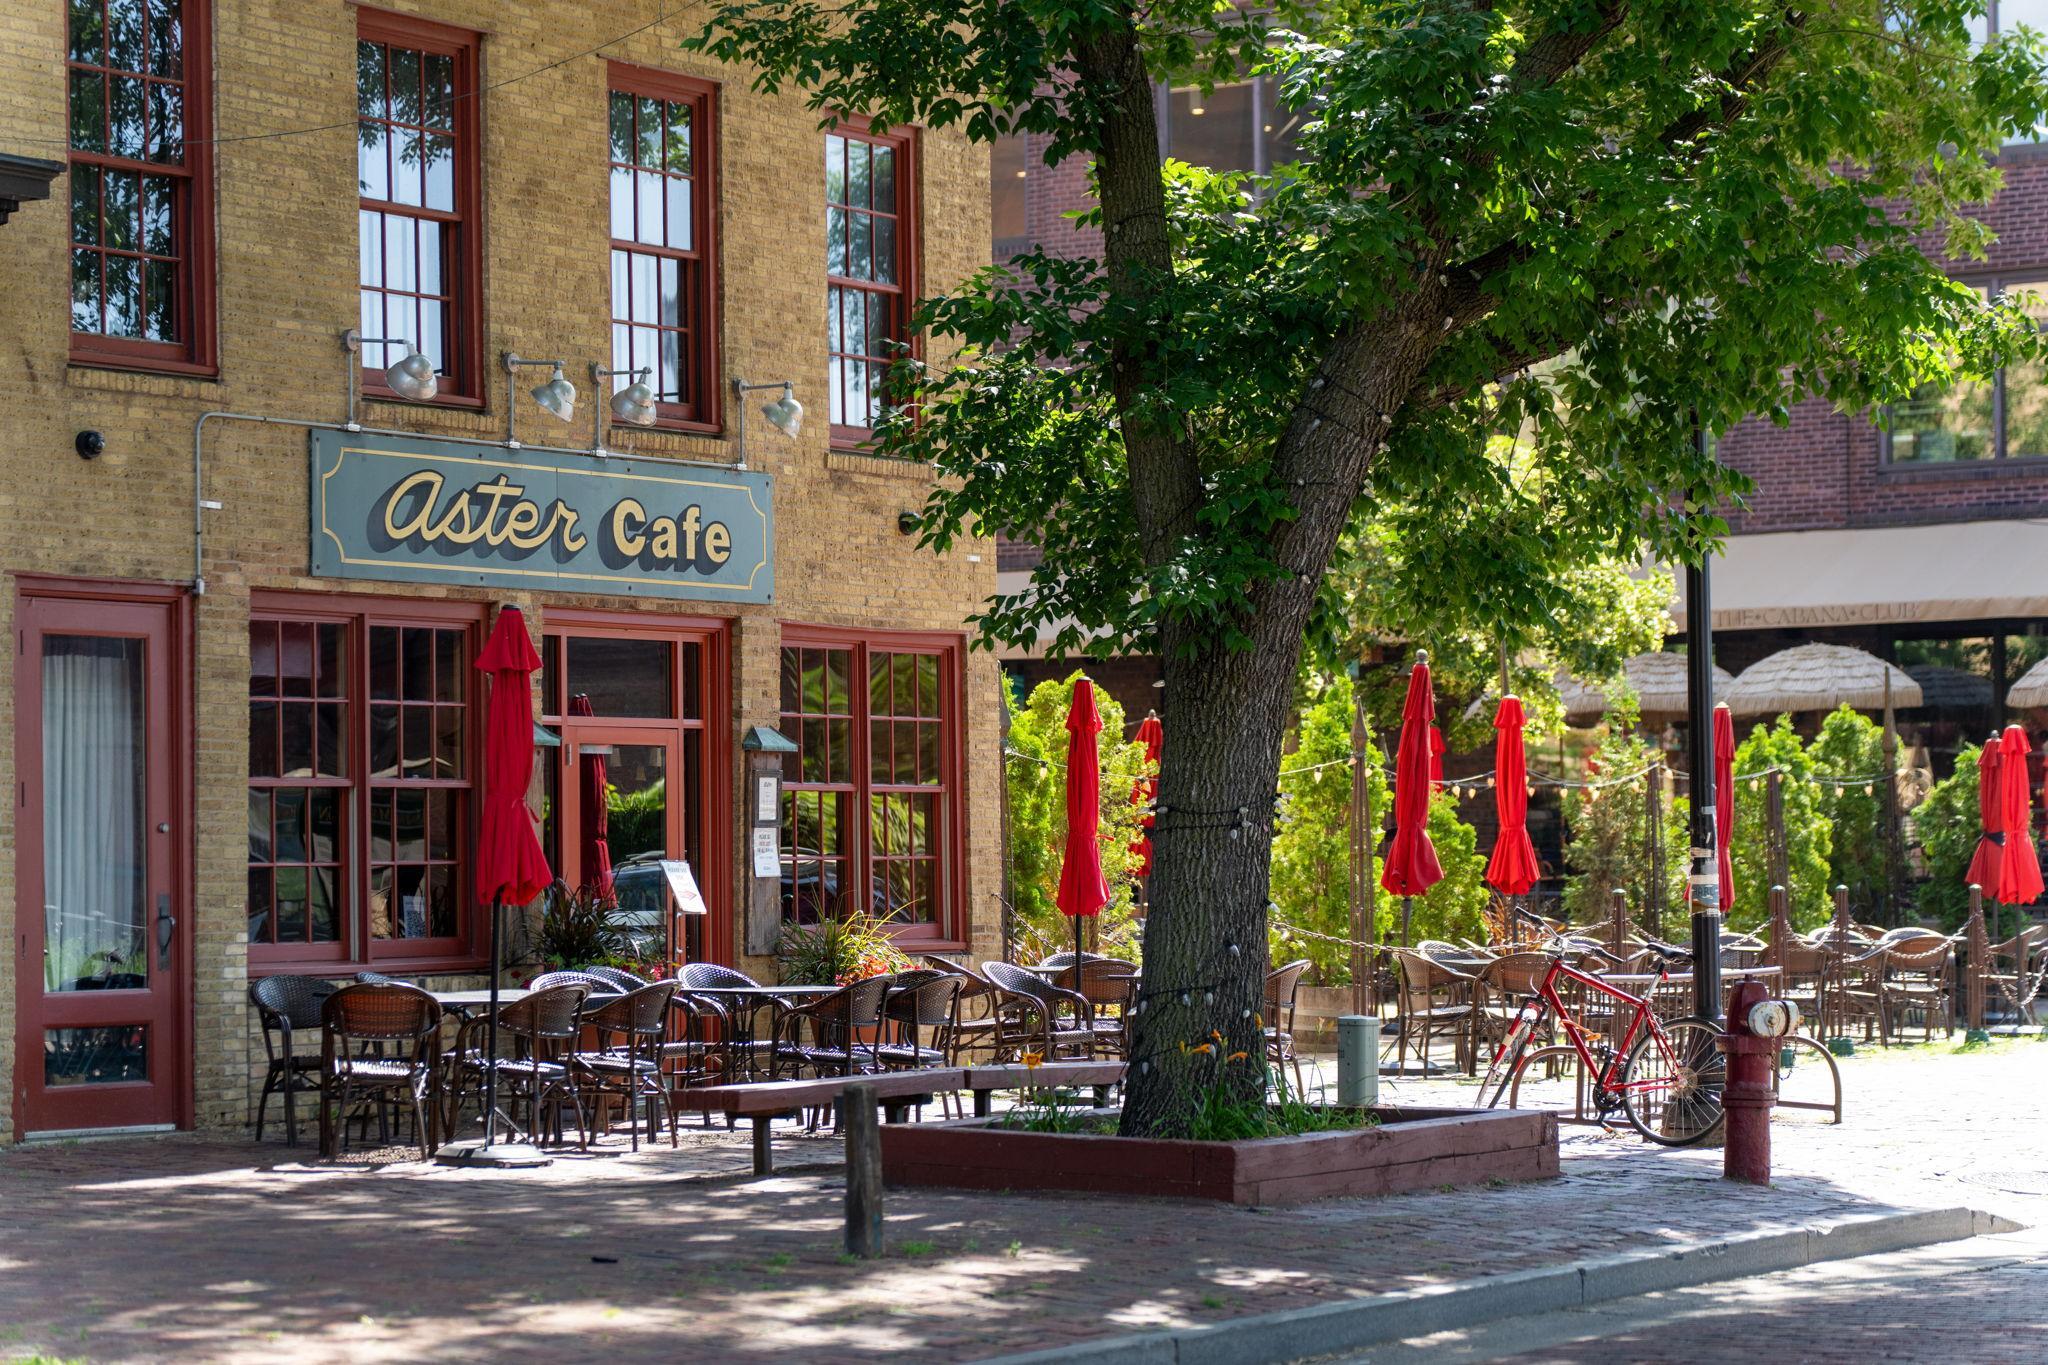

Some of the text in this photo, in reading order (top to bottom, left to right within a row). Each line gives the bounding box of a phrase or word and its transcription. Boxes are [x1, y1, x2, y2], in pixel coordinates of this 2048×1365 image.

[380, 468, 732, 564] Aster Cafe
[1713, 602, 1919, 628] THE CABANA CLUB
